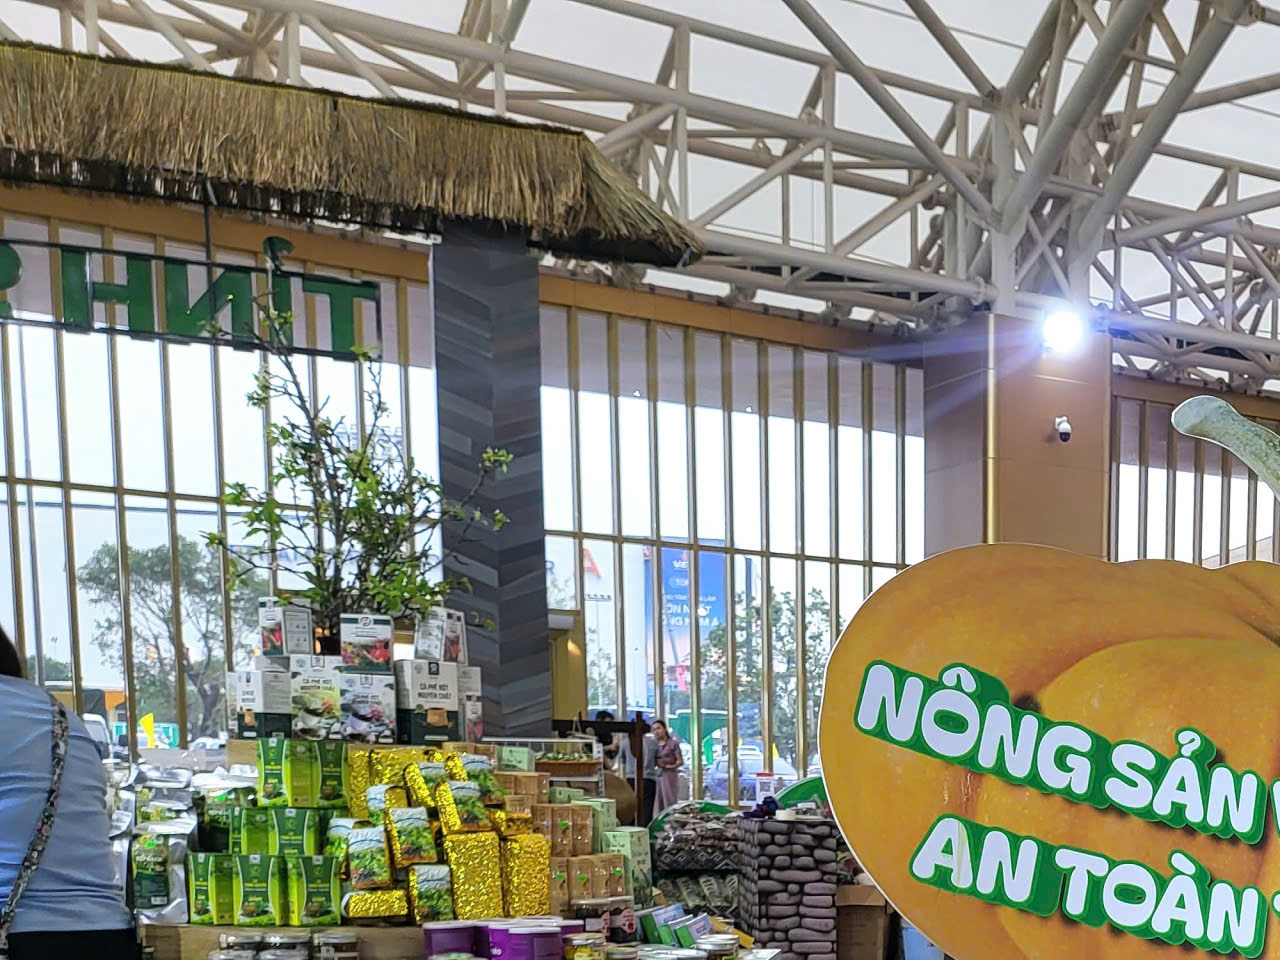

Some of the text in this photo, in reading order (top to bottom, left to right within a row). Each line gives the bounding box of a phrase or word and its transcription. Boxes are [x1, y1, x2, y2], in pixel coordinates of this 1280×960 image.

[856, 663, 1092, 795] NÔNG
[1104, 729, 1258, 833] SẢN
[911, 816, 1038, 902] AN
[1054, 851, 1259, 948] TOÀN
